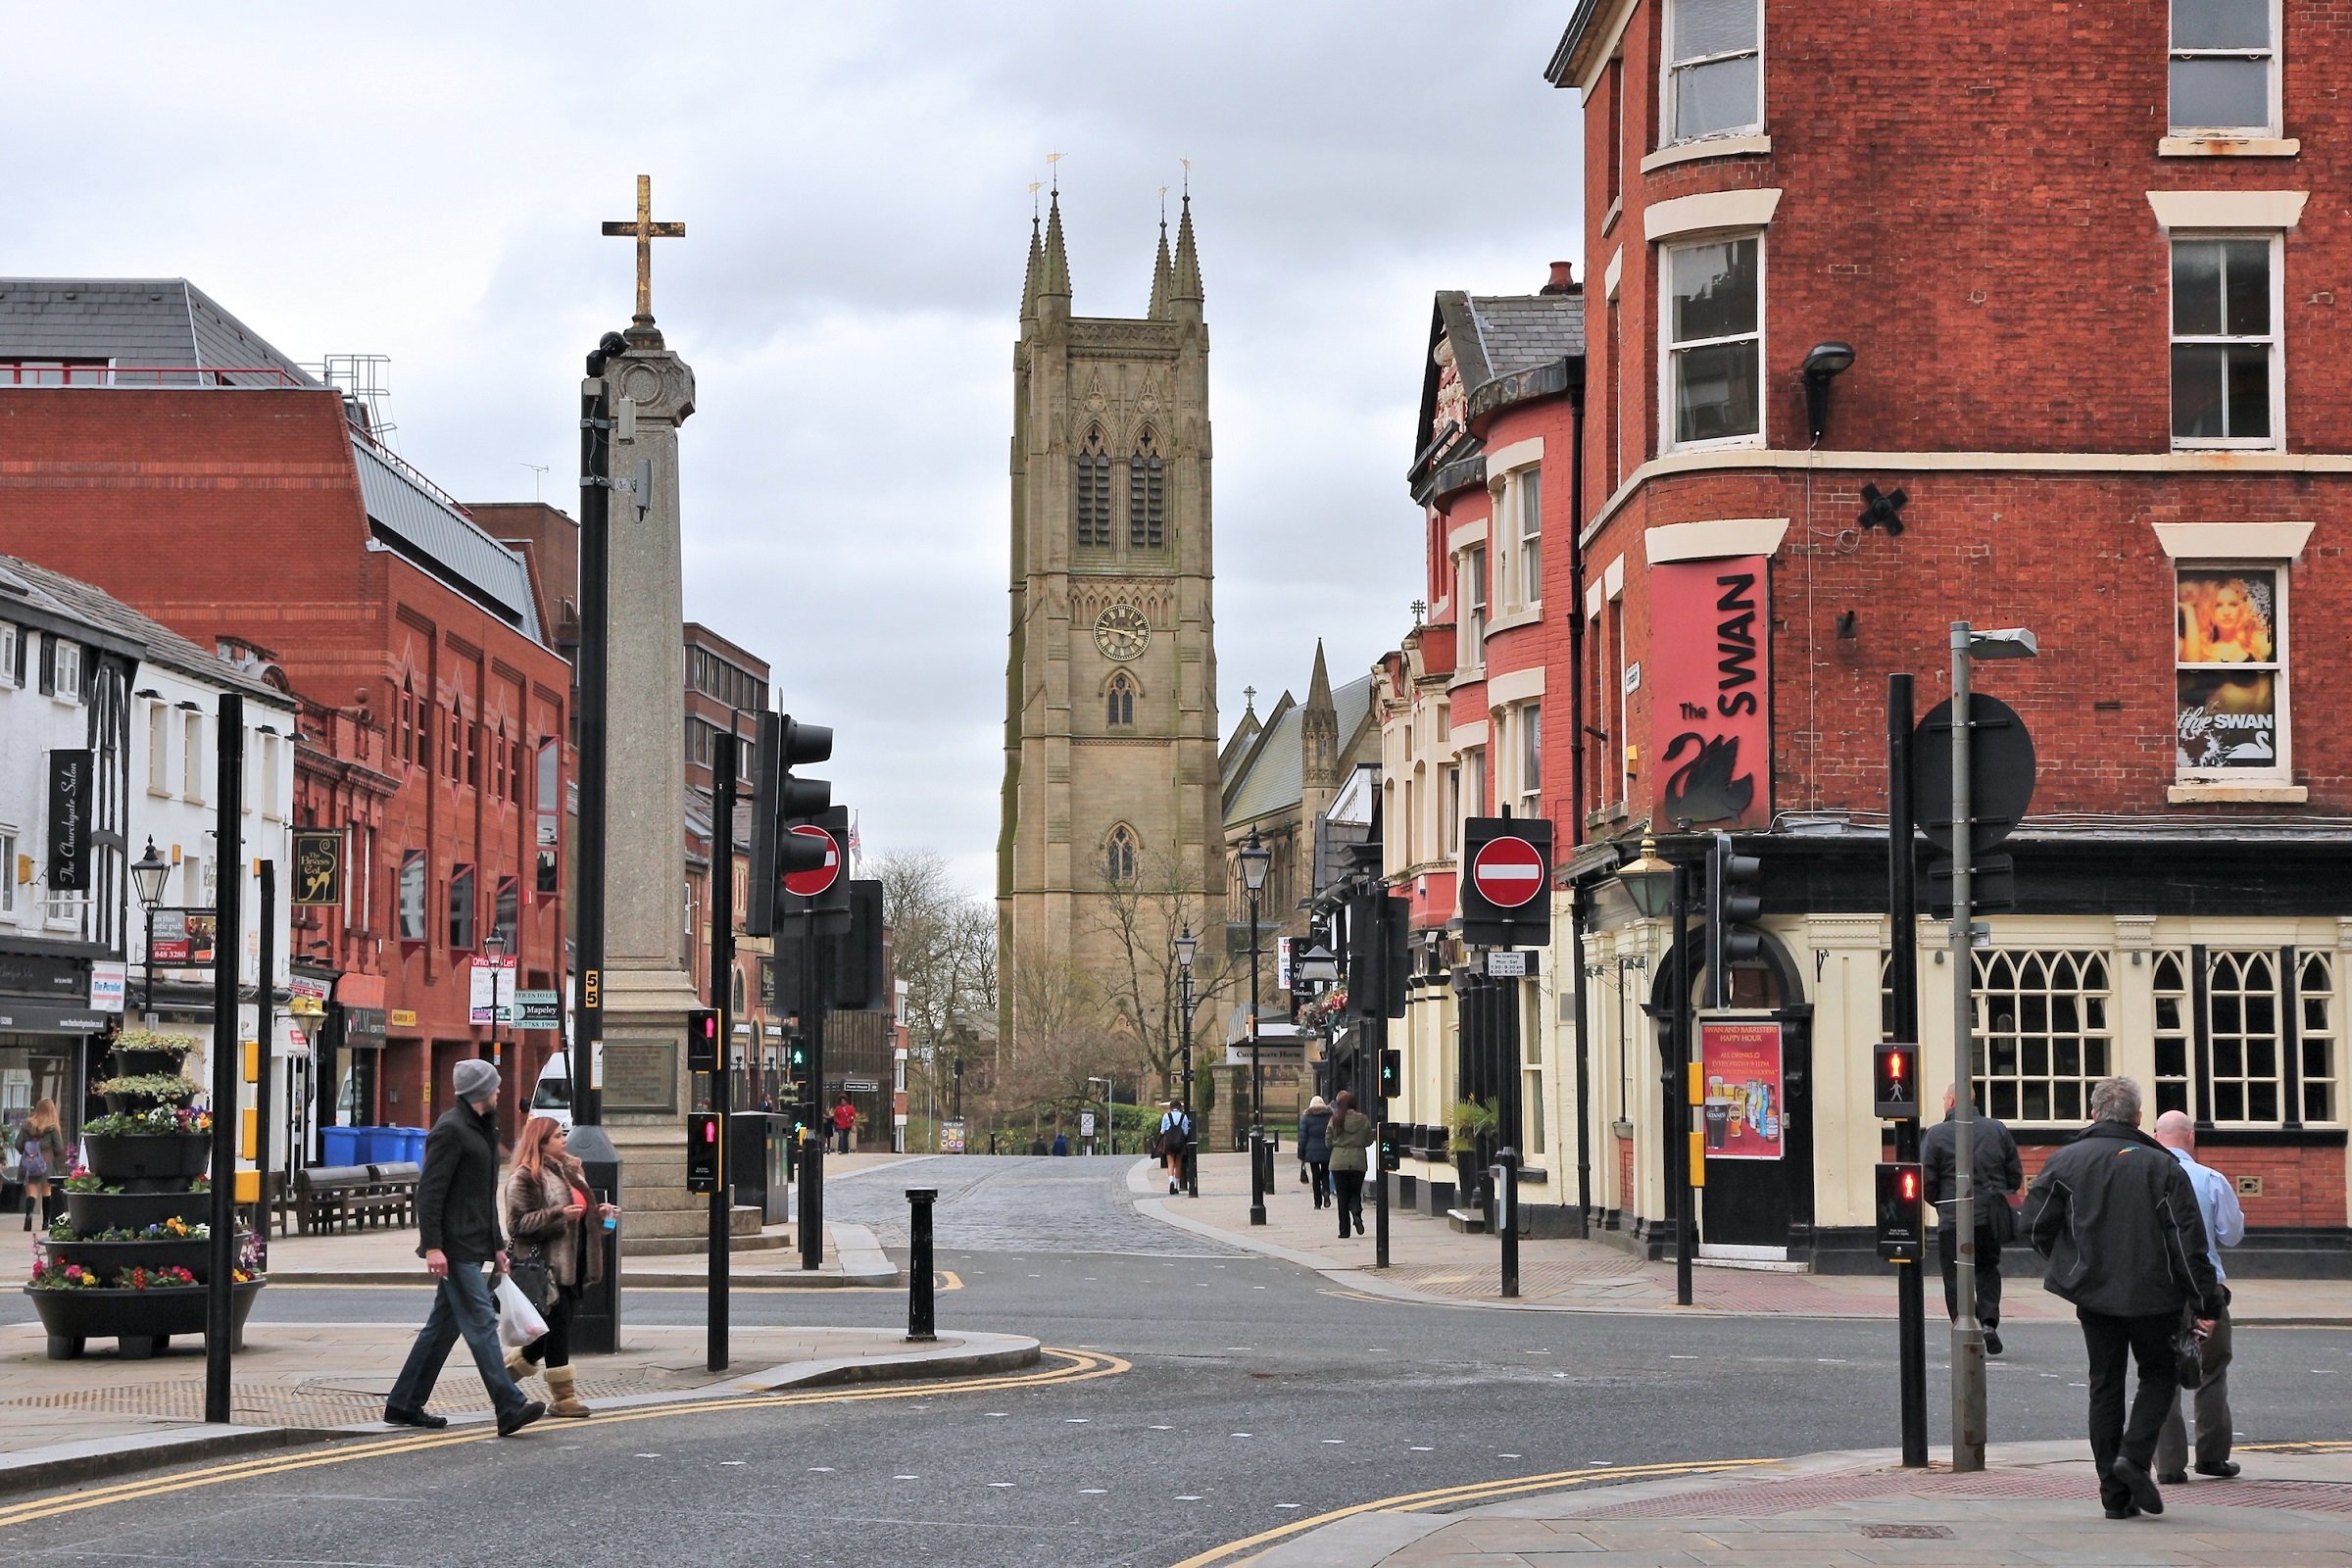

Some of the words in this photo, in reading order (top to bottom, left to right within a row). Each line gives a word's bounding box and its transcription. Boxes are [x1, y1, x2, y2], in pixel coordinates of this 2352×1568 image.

[1679, 702, 1707, 719] The
[1716, 572, 1756, 717] SWAN
[2177, 706, 2212, 732] the
[2214, 713, 2273, 729] SWAN
[60, 762, 77, 797] Salon
[59, 799, 79, 858] Churchgate
[301, 856, 330, 865] Brass
[304, 864, 320, 874] Cat
[59, 860, 75, 884] The
[169, 922, 183, 931] pub
[312, 981, 325, 990] News
[526, 1005, 557, 1015] Mapeley
